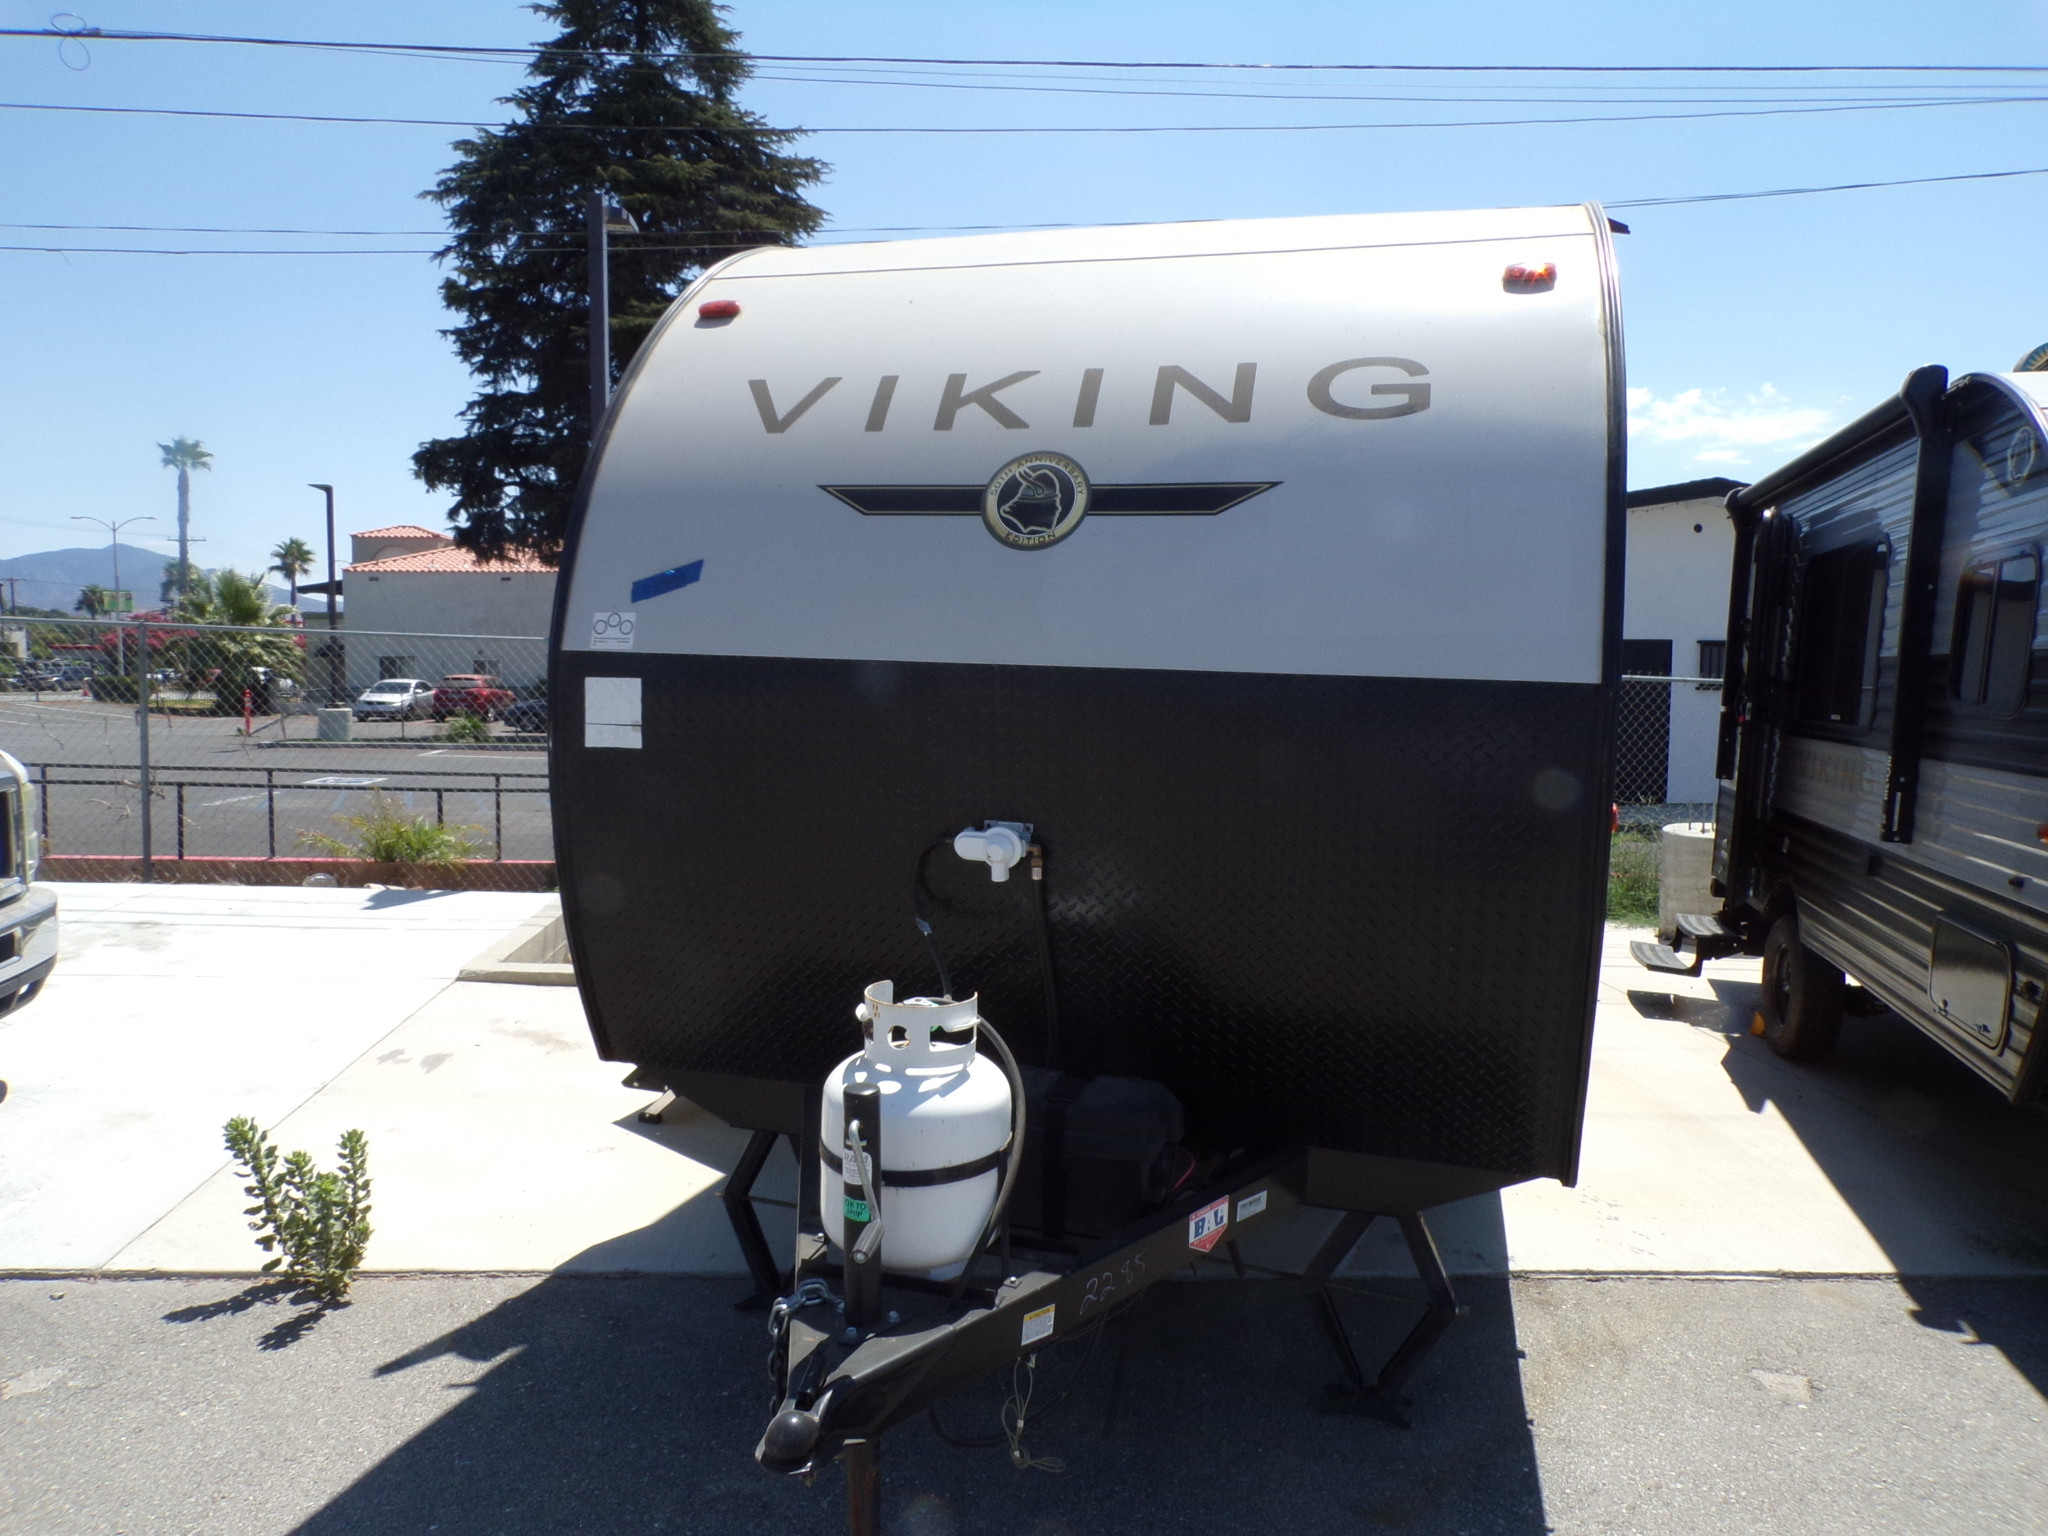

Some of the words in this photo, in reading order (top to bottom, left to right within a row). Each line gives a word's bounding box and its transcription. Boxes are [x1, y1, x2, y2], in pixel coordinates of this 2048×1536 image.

[748, 356, 1431, 433] VIKING
[1016, 455, 1085, 496] ANNIVERSARY
[1003, 530, 1057, 546] EDITION
[846, 1207, 864, 1218] SHIP
[855, 1201, 867, 1211] TO
